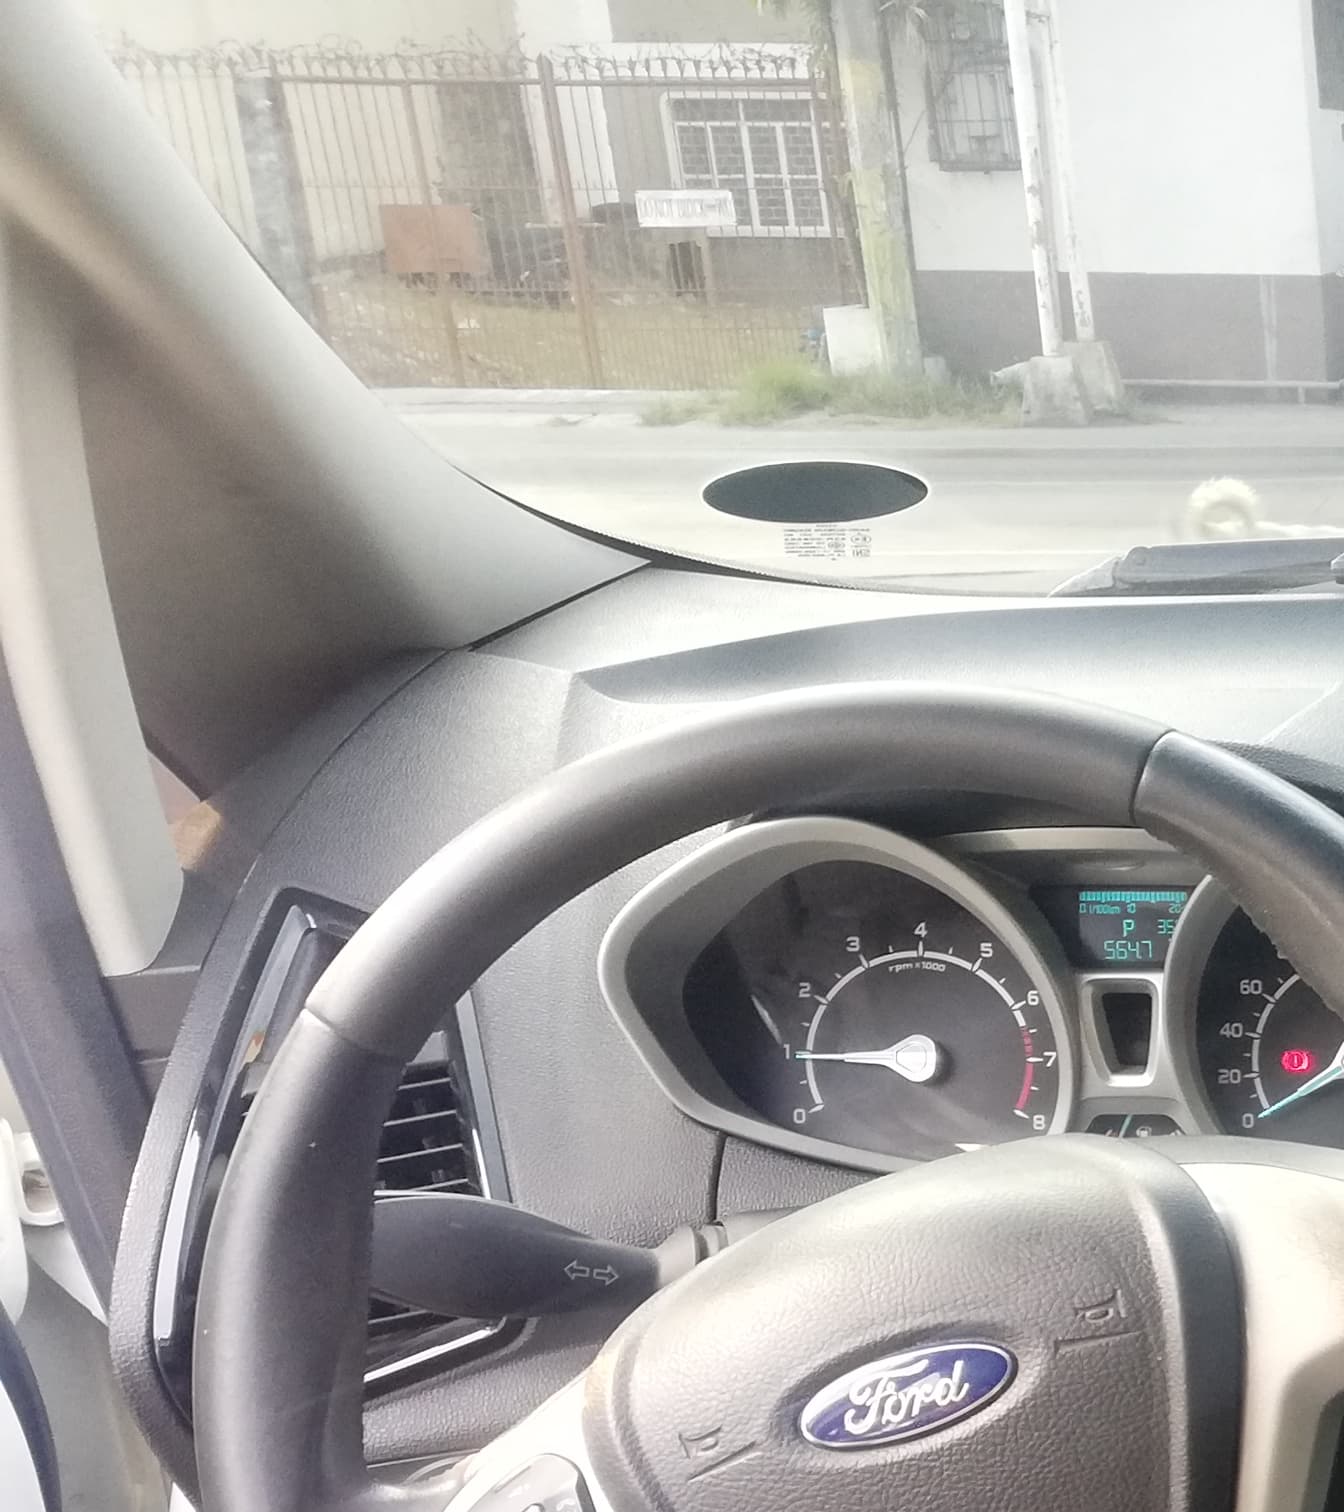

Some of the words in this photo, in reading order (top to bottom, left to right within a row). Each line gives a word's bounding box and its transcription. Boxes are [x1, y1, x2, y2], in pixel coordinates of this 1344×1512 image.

[914, 921, 928, 938] 4
[1123, 919, 1135, 937] P
[846, 936, 860, 952] 3
[980, 942, 993, 958] 5
[888, 962, 913, 973] rpm
[798, 982, 811, 998] 2
[1239, 979, 1263, 995] 60
[1027, 990, 1040, 1006] 6
[1219, 1022, 1243, 1038] 40
[783, 1043, 790, 1060] 1
[1043, 1051, 1057, 1068] 7
[1218, 1068, 1241, 1084] 20
[793, 1108, 806, 1124] 0
[1032, 1114, 1046, 1130] 8
[1242, 1113, 1255, 1128] 0
[844, 1358, 971, 1435] Ford
